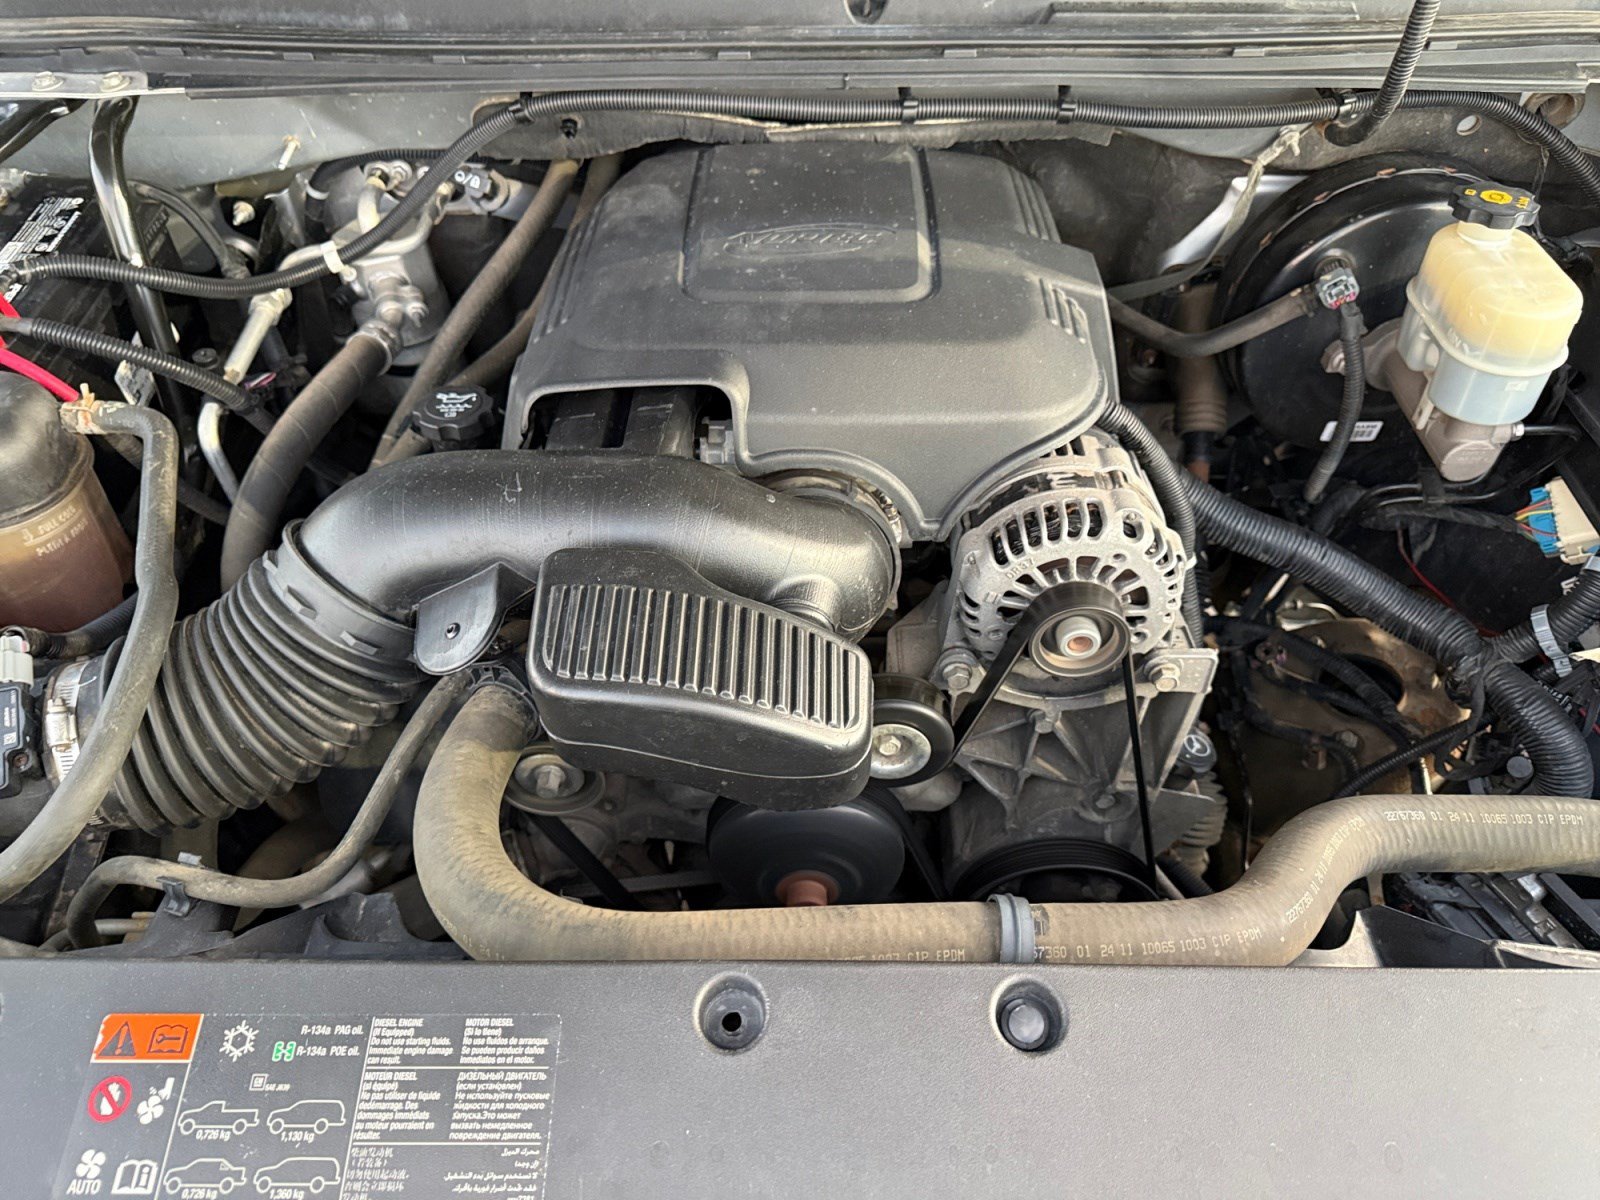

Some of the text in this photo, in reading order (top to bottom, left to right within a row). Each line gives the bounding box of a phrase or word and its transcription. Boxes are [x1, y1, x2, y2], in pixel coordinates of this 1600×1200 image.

[1431, 811, 1443, 821] 01
[1449, 811, 1461, 822] 24
[1480, 813, 1508, 824] 10065
[1512, 814, 1533, 824] 1003
[1537, 814, 1555, 825] CIP
[1559, 814, 1584, 825] EPDM
[1076, 945, 1091, 958] 01
[1101, 943, 1115, 958] 24
[1119, 943, 1133, 956] 11
[1141, 941, 1176, 955] 10065
[1179, 938, 1206, 952] 1003
[1211, 935, 1231, 948] CIP
[1236, 927, 1263, 945] EPDM
[936, 949, 965, 961] EPDM
[374, 1018, 424, 1027] DIESEL ENGINE
[465, 1018, 514, 1026] MOTOR DIESEL
[301, 1025, 331, 1035] R-134a
[334, 1025, 352, 1035] PAG
[296, 1046, 327, 1056] R-134a
[330, 1046, 347, 1056] POE
[369, 1047, 453, 1057] Immediate engine damage
[364, 1072, 418, 1080] MOTEUR DIESEL
[457, 1071, 547, 1081] ДИЗЕЛЬНЫЙ ДВИГАТЕЛЬ
[455, 1092, 550, 1101] Не используйте пусковые
[219, 1130, 230, 1141] kg
[304, 1131, 314, 1143] kg
[66, 1180, 101, 1194] AUTO
[204, 1189, 218, 1200] kg
[292, 1189, 304, 1200] kg
